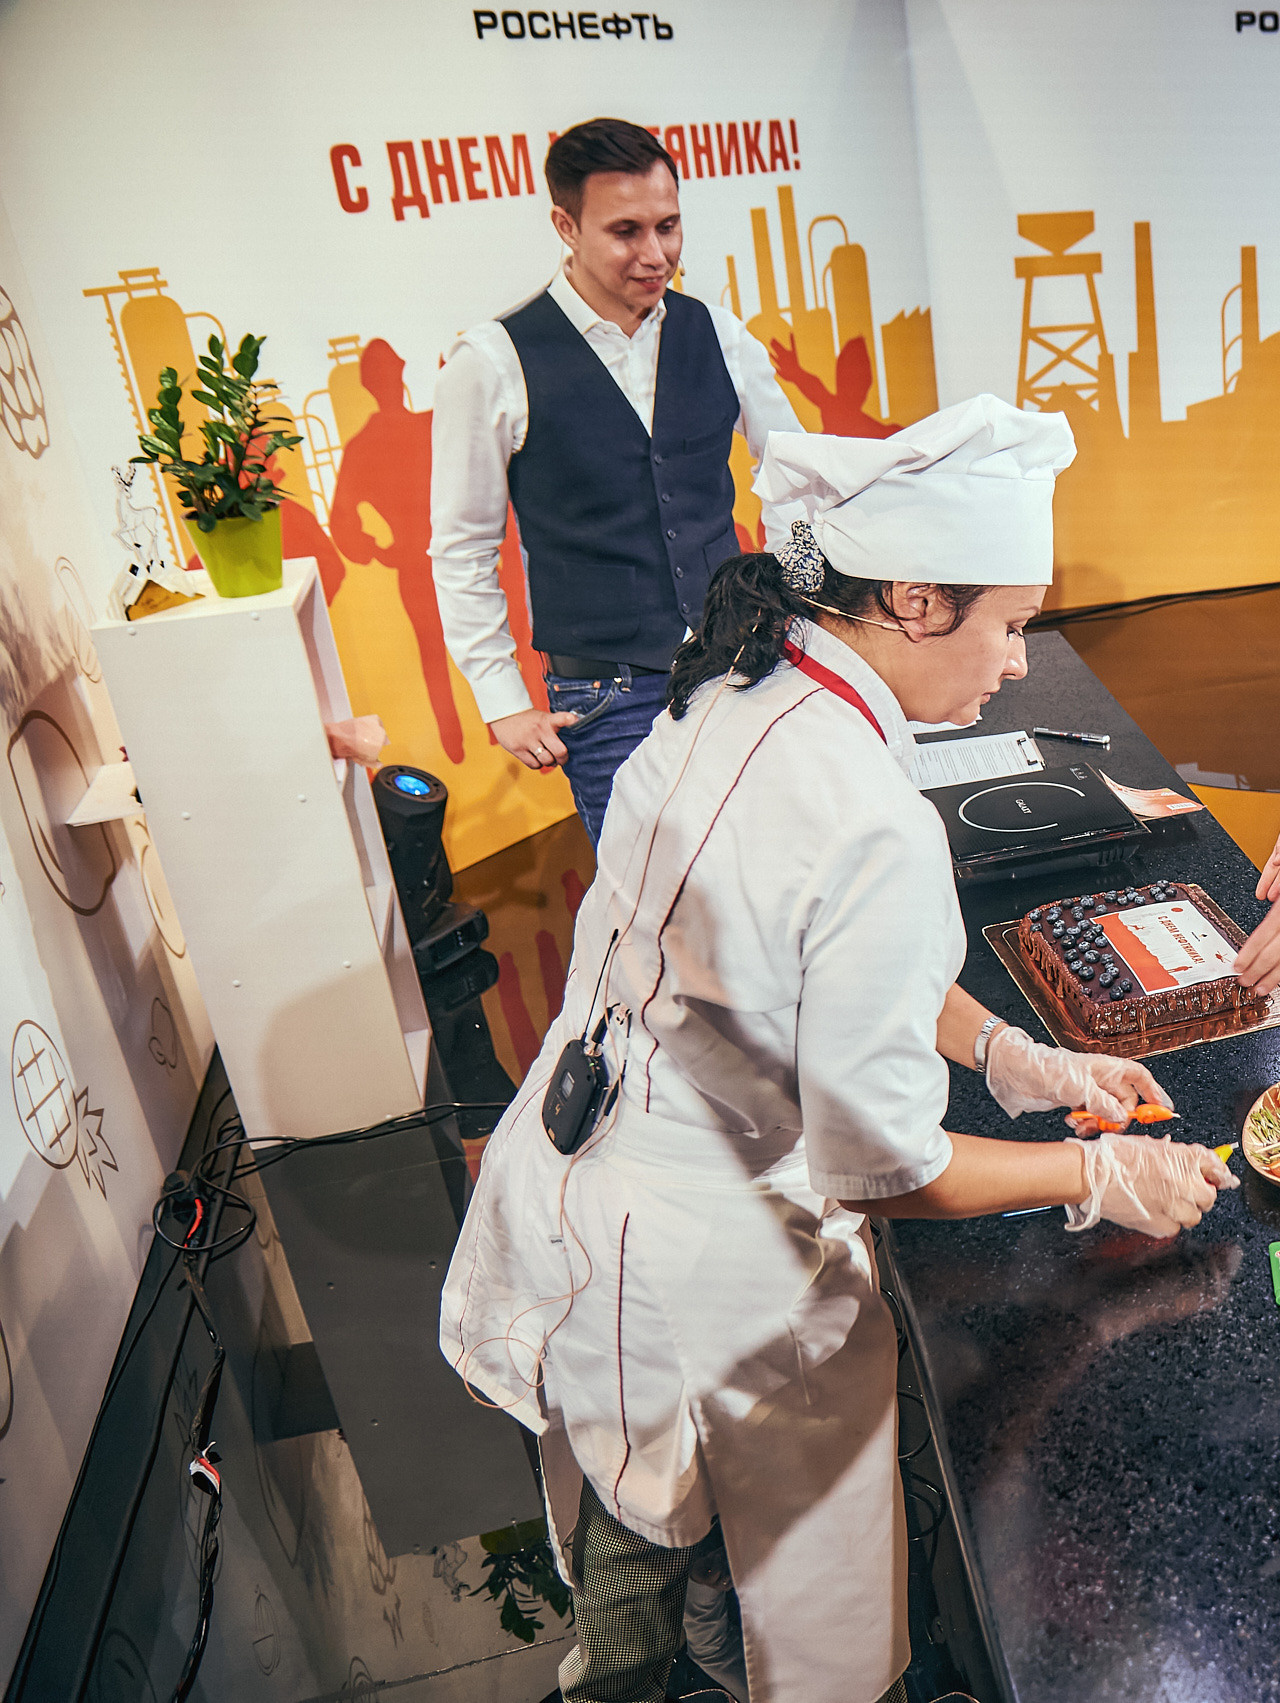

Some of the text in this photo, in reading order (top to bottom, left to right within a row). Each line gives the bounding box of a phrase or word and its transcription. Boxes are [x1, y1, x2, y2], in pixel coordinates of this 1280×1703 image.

[473, 10, 674, 40] РОСНЕФТЬ
[329, 118, 800, 221] С ДНЕМ ЯНИКА!
